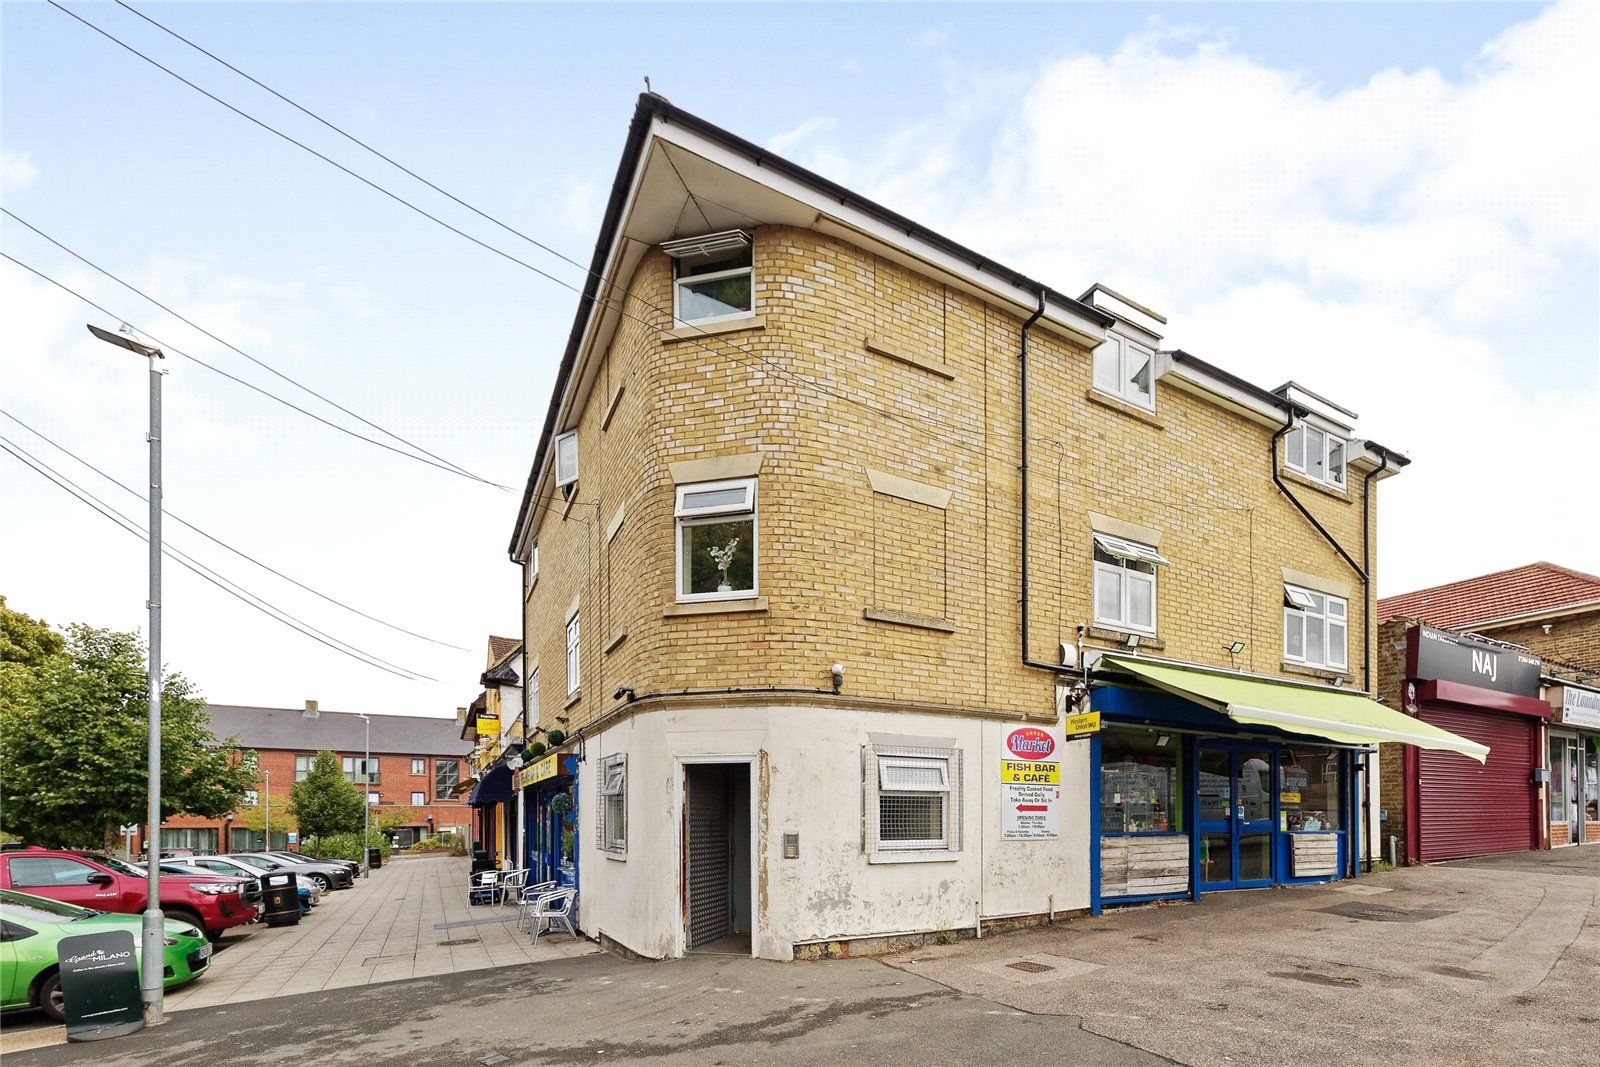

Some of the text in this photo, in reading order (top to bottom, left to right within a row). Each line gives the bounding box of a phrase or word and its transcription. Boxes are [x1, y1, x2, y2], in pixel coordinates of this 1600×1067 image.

[1422, 630, 1437, 640] INDIAN
[1472, 650, 1497, 682] NAJ
[1565, 689, 1576, 706] The
[1070, 717, 1088, 725] Western
[1011, 735, 1051, 753] Market
[1006, 763, 1056, 772] FISH BAR
[65, 950, 131, 964] Grand MILANO
